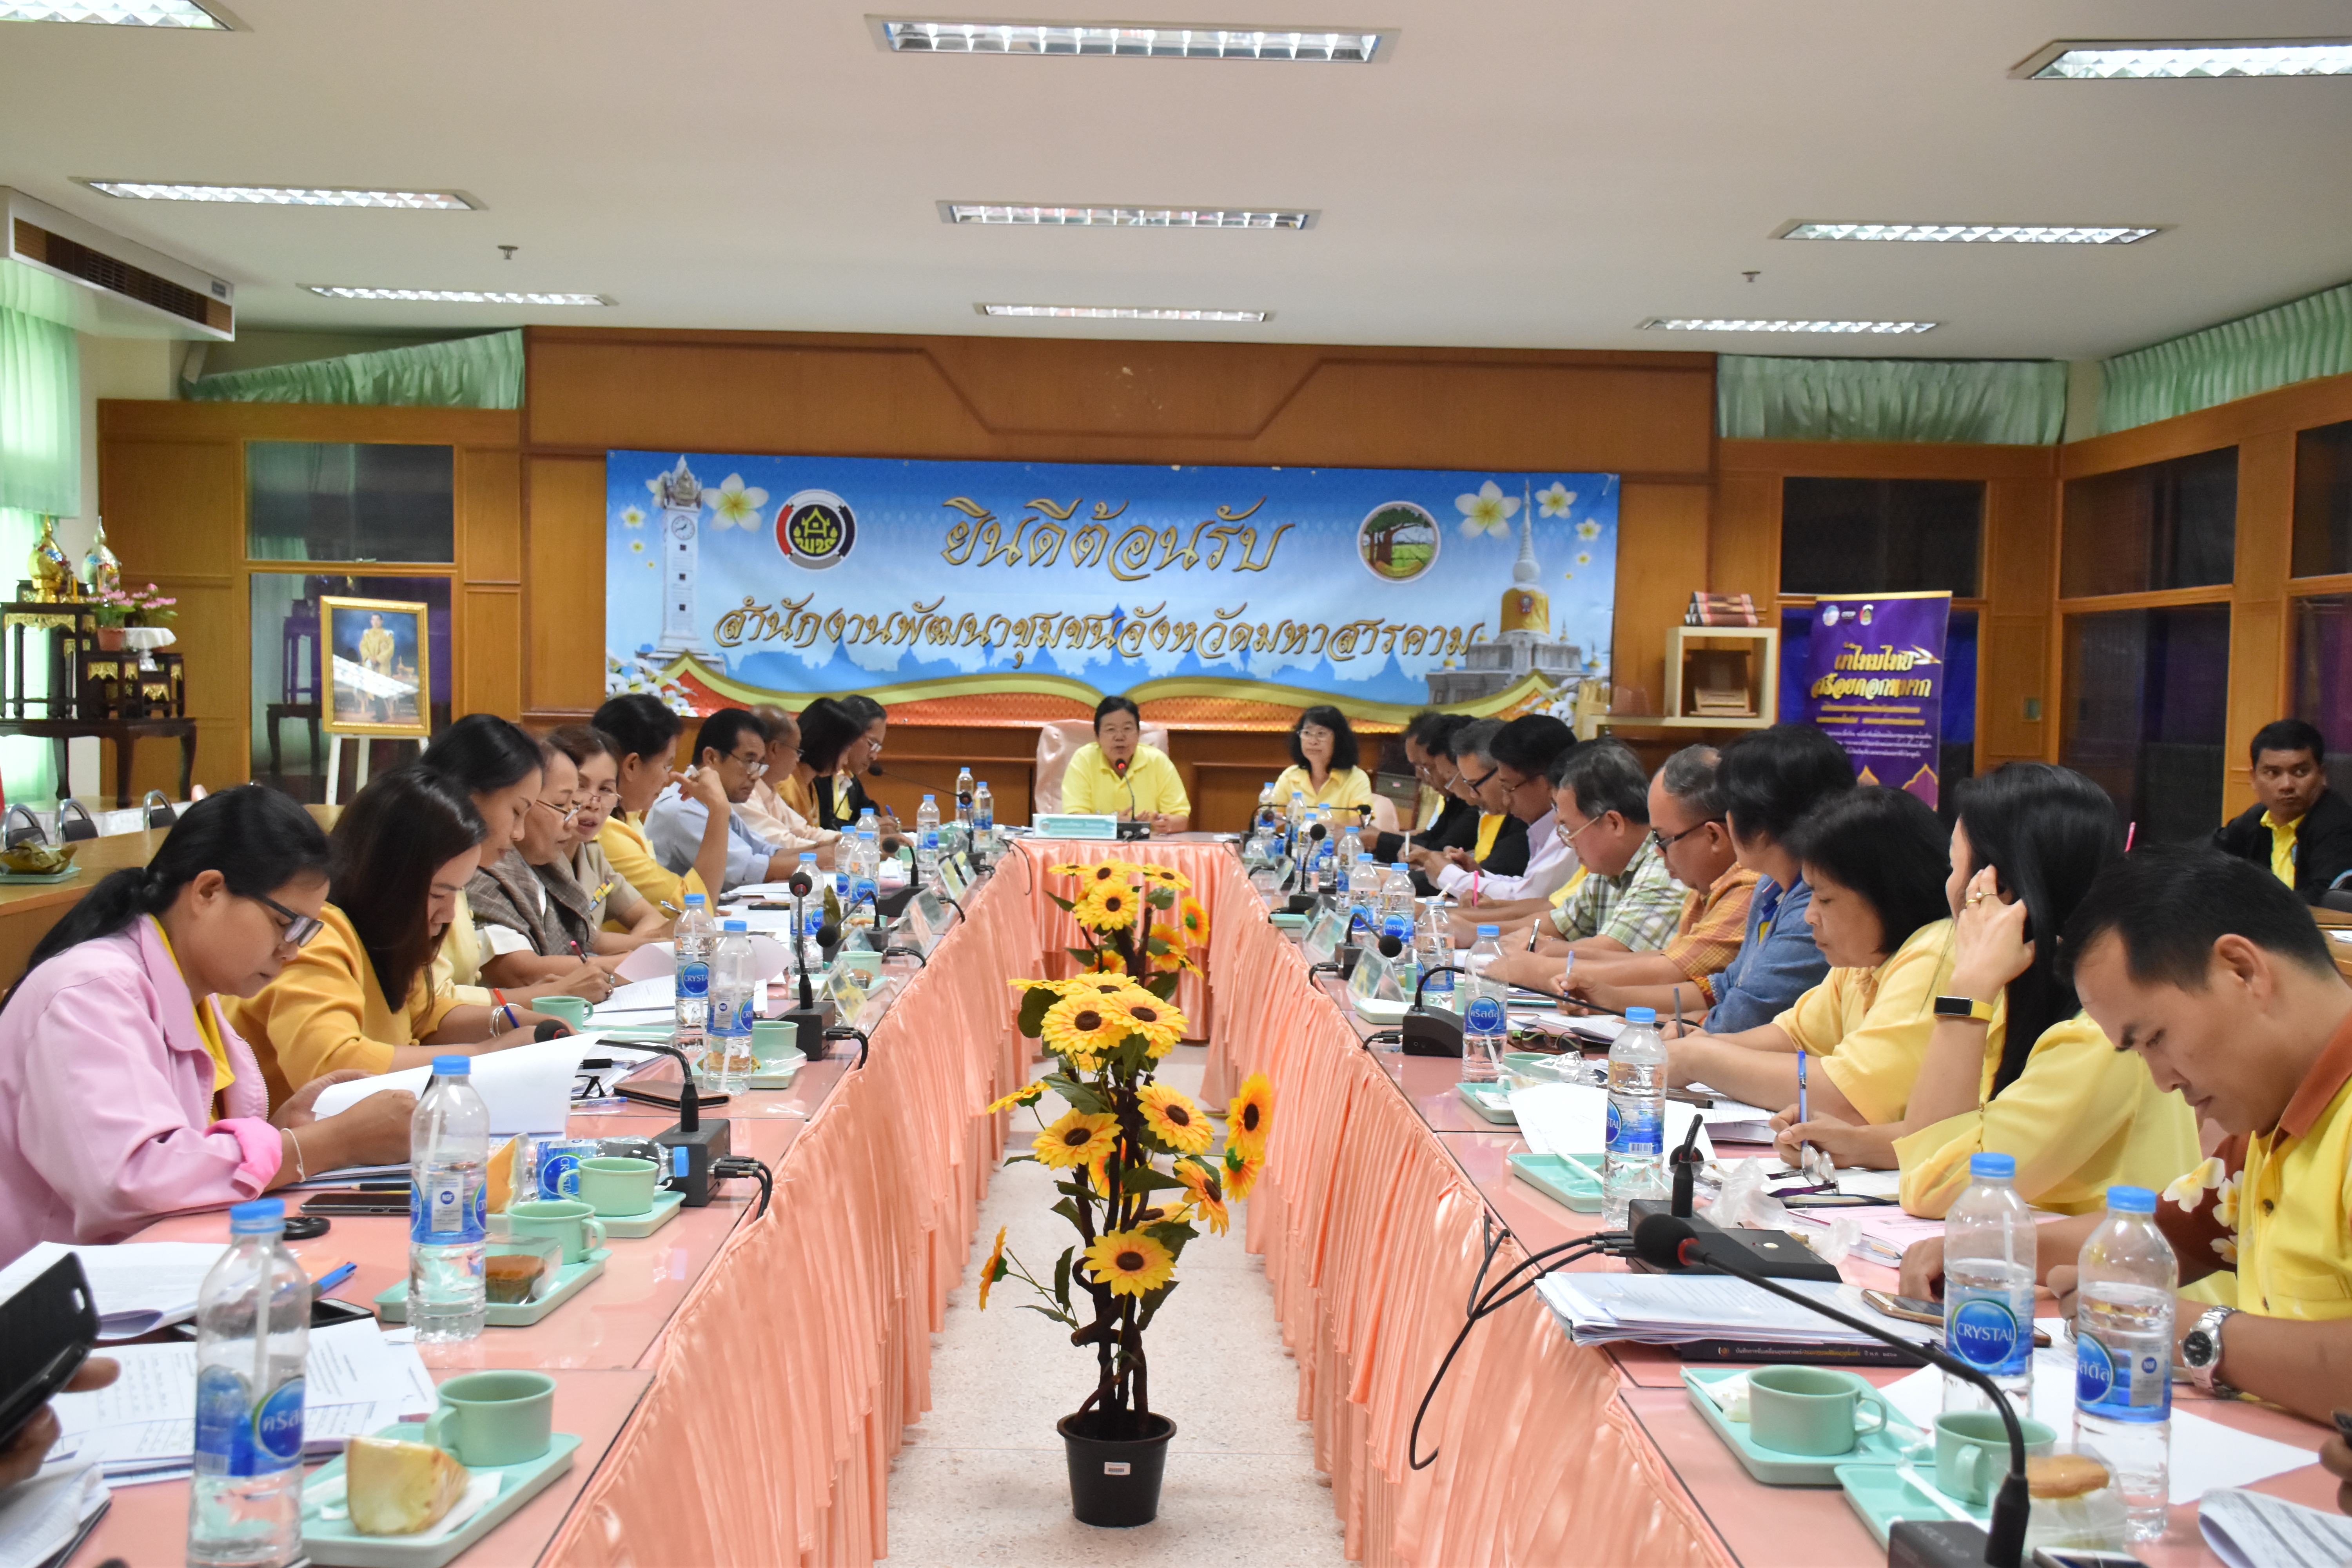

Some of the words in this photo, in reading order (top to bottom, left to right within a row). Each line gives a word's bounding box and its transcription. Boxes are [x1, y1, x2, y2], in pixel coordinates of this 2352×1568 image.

[941, 496, 1295, 581] ยินดีต้อนรับ
[714, 592, 1485, 669] สำนักงานพัฒนาชุมชนจังหวัดมหาสารคาม
[1956, 1322, 2014, 1341] CRYSTAL
